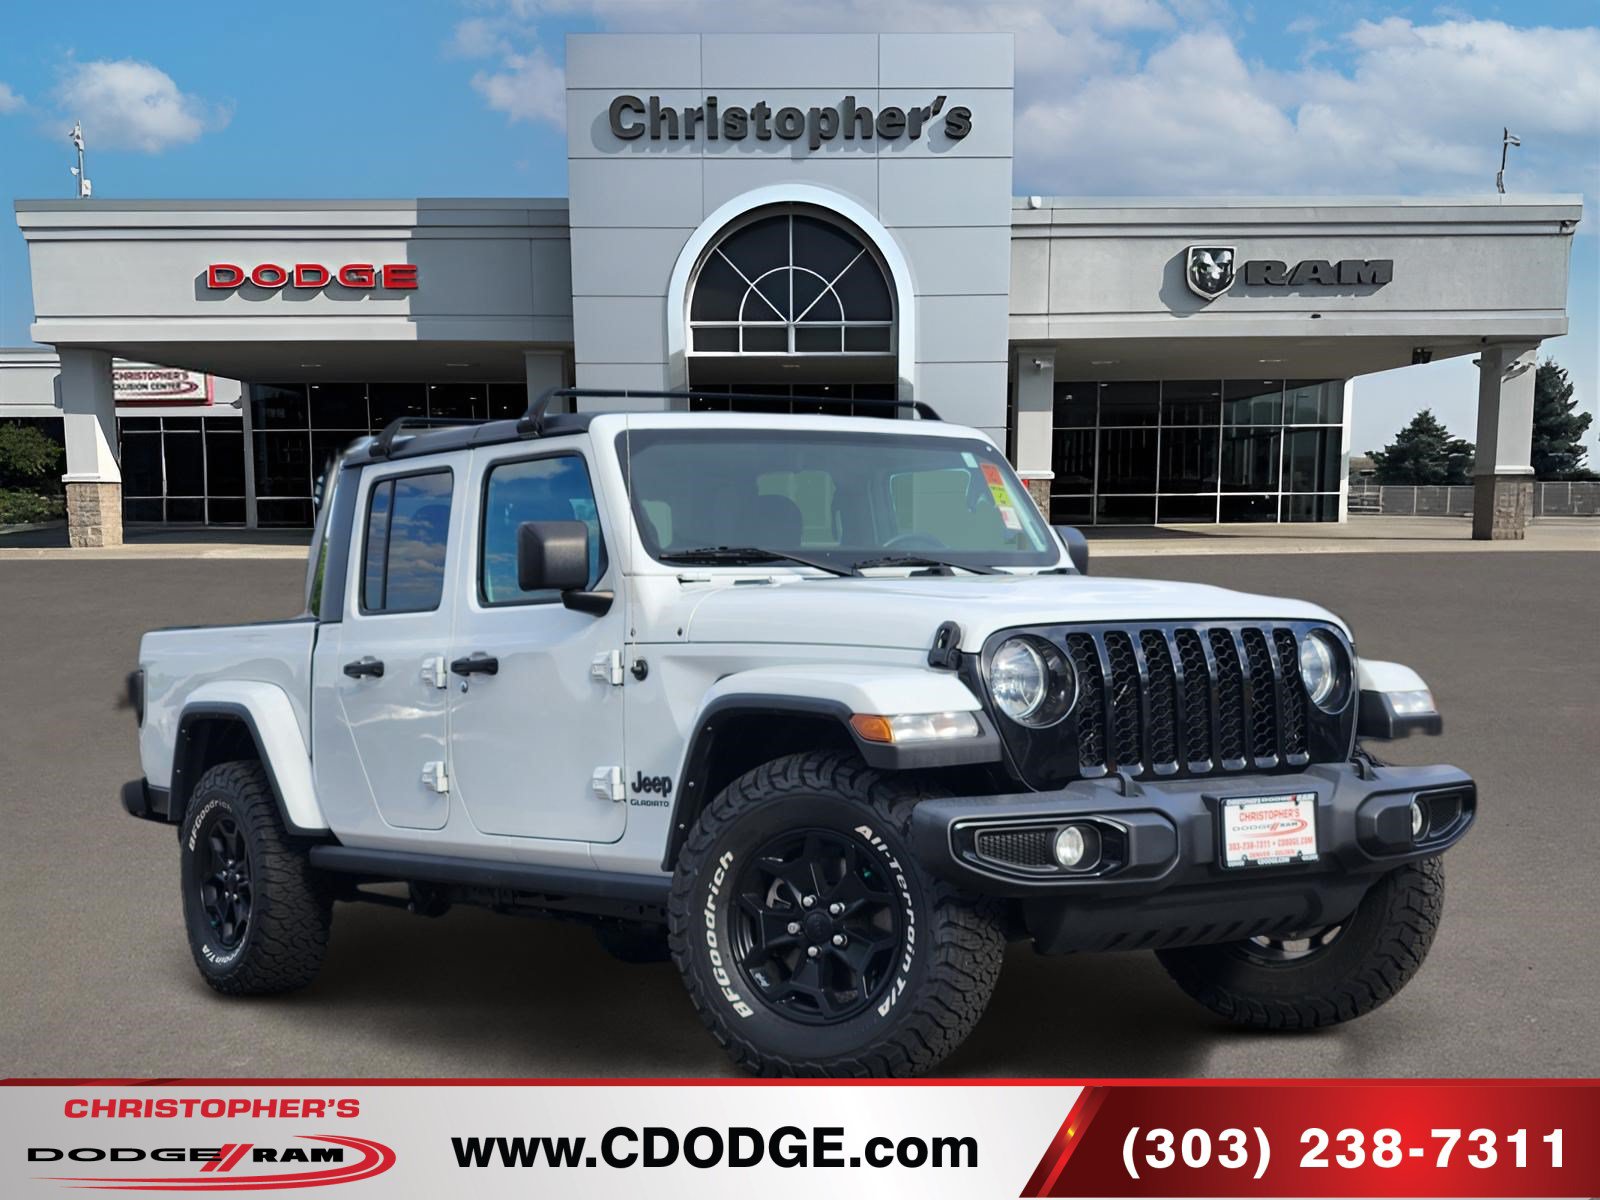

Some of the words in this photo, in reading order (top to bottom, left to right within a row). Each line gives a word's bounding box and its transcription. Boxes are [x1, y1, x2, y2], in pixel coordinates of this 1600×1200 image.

[608, 95, 973, 151] Christopher's
[207, 263, 418, 289] DODGE
[1245, 259, 1394, 286] RAM
[150, 382, 181, 390] CENTER
[631, 770, 672, 798] Jeep
[188, 799, 233, 852] BFGoodrich
[1240, 808, 1300, 822] CHRISTOPHER'S
[703, 851, 754, 1018] BFGoodrich
[878, 976, 906, 1017] T/A
